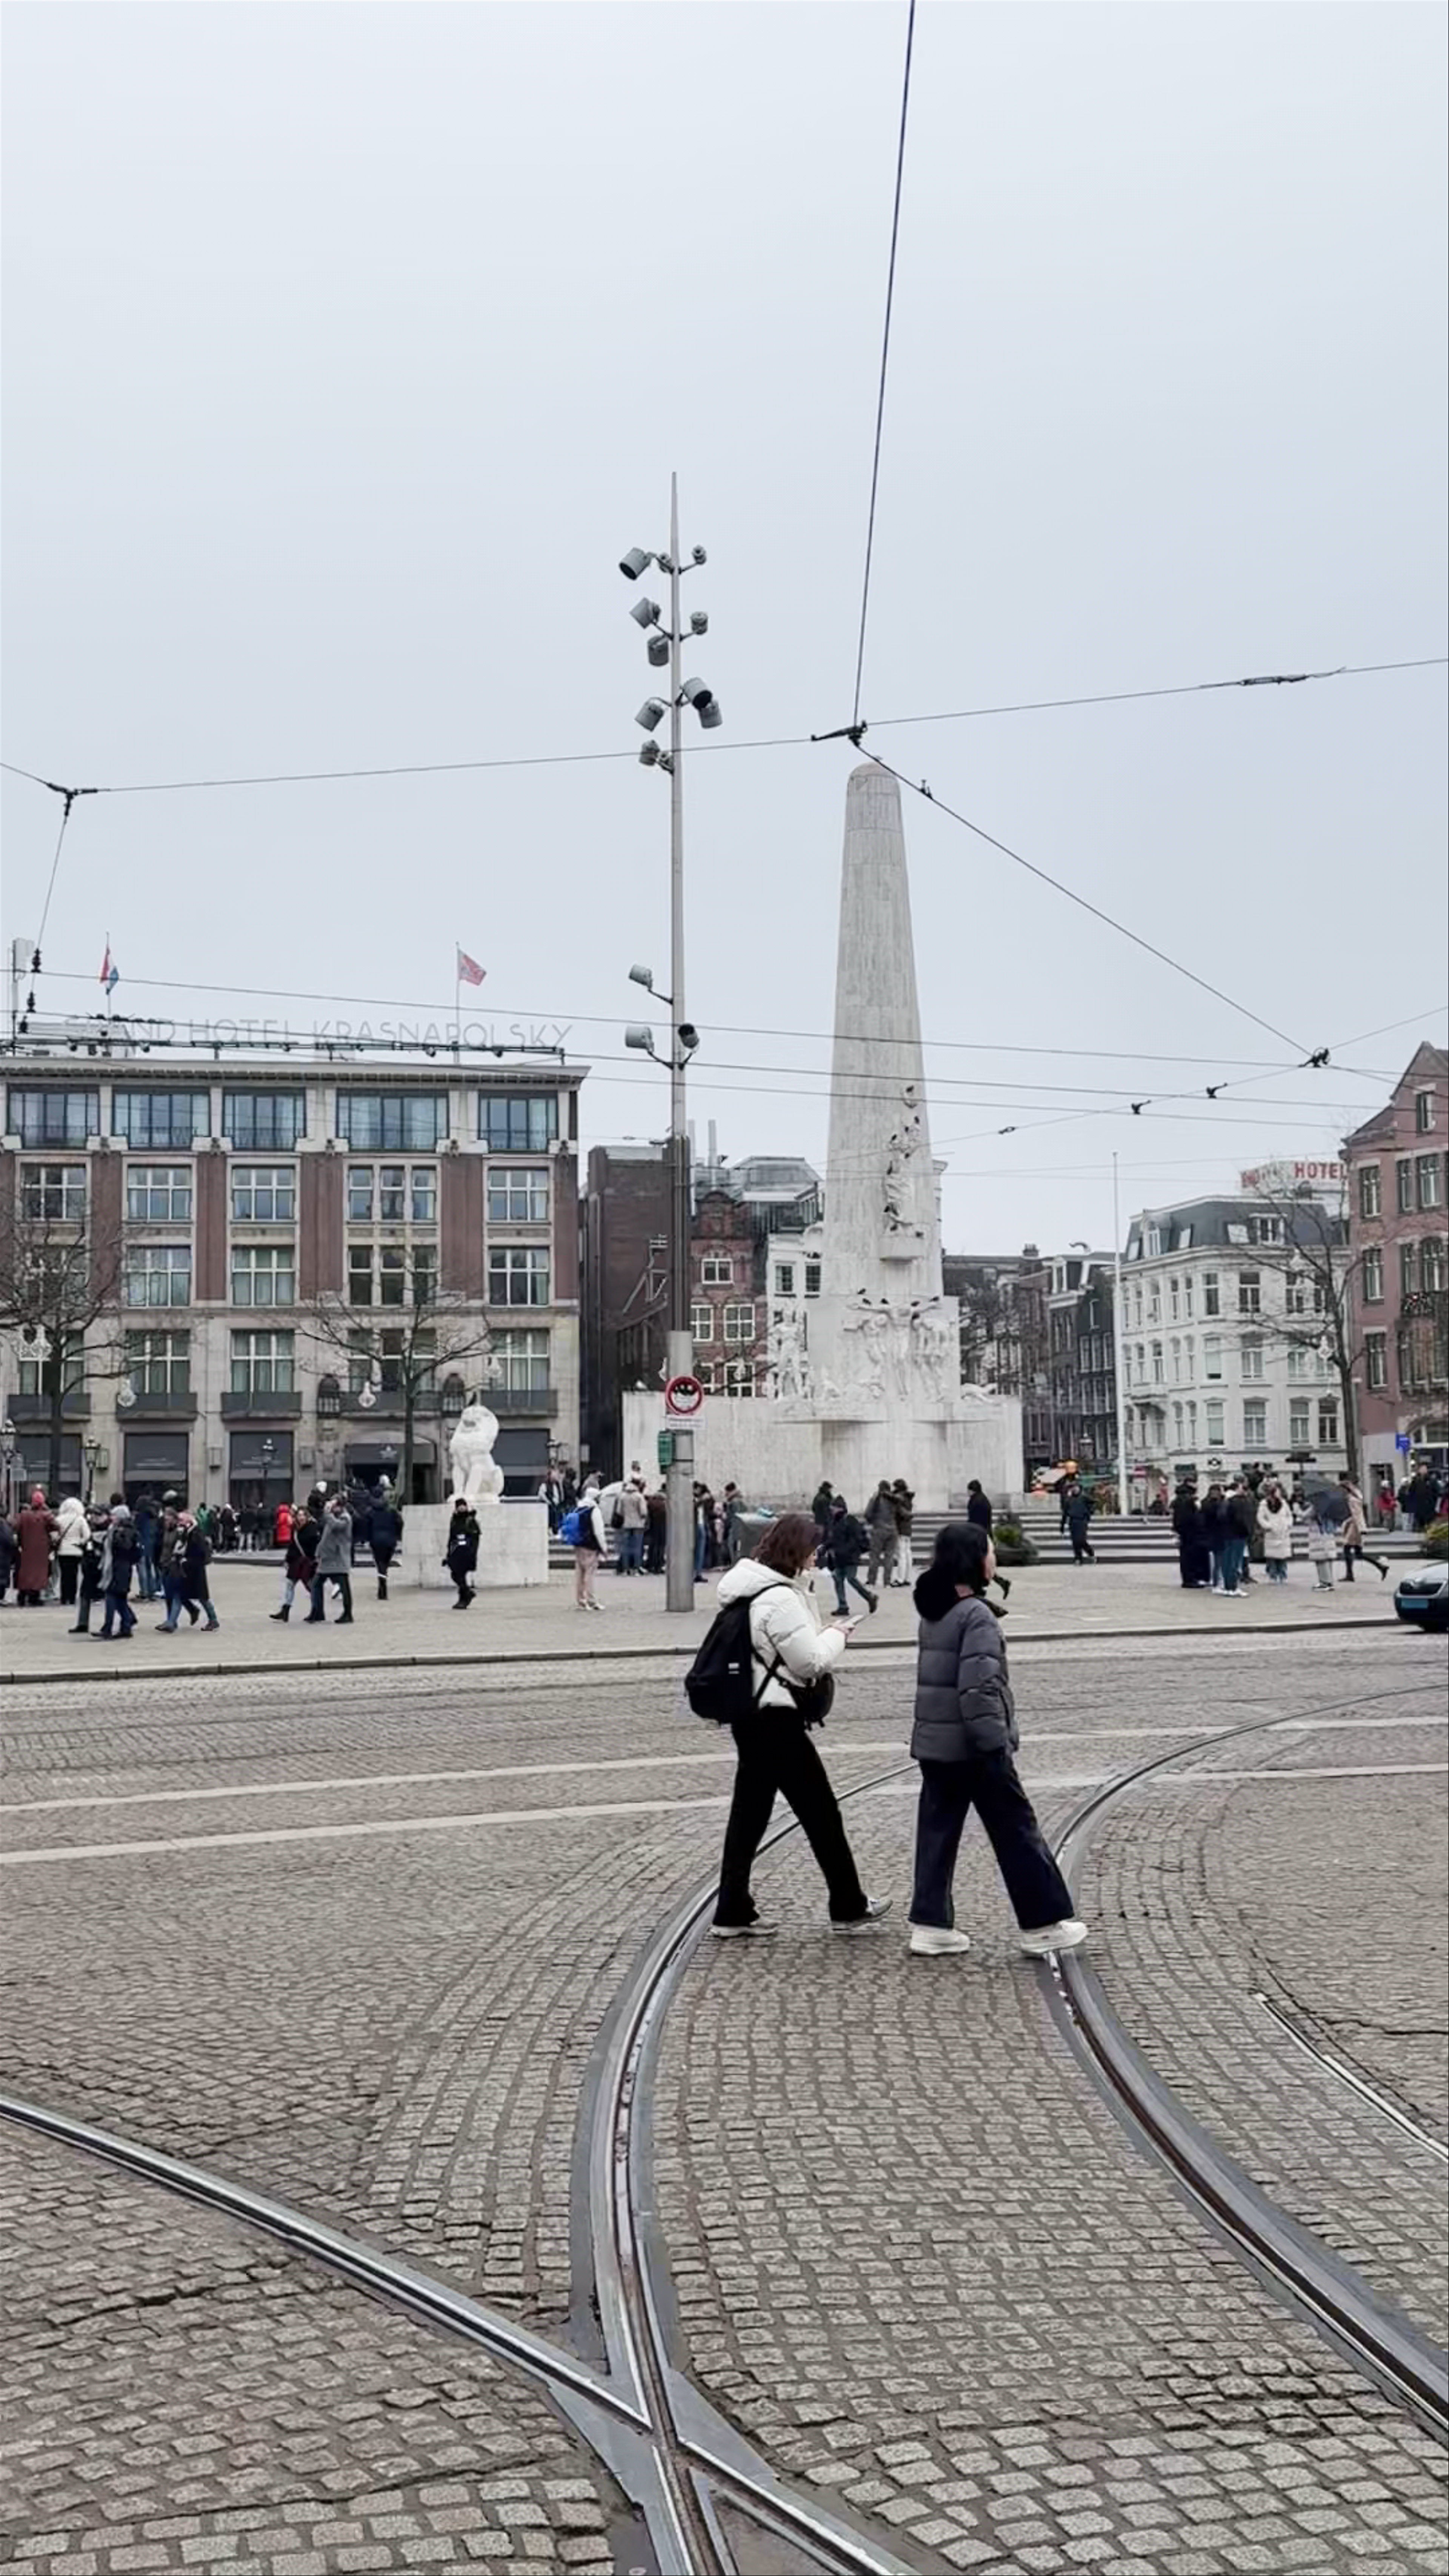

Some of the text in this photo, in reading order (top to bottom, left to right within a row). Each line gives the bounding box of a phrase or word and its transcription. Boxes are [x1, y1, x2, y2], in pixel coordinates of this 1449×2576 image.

[65, 1018, 573, 1048] AND HOTEL KRASNAPOLSKY
[1294, 1162, 1347, 1179] HOTEL
